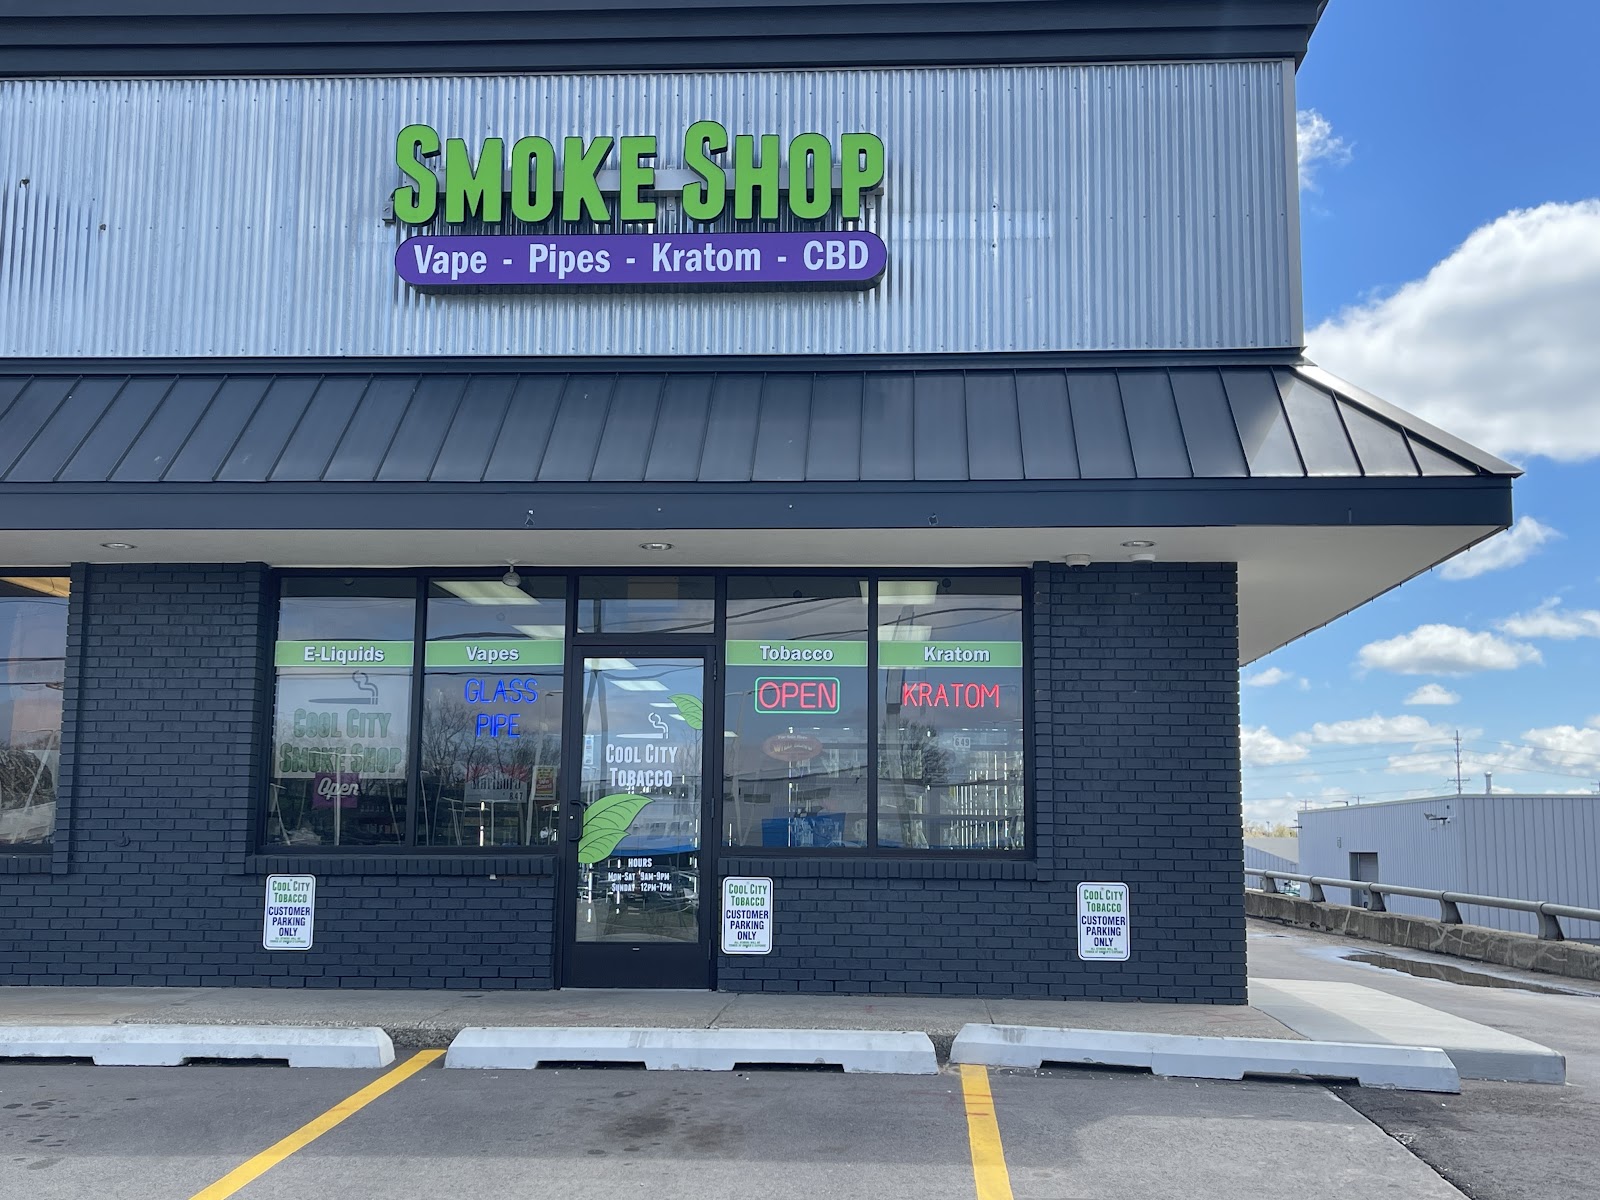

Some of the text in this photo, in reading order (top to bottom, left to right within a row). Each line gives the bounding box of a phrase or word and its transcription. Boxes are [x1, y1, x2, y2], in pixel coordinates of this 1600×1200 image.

[394, 120, 885, 225] SMOKE SHOP
[413, 244, 488, 280] Vape
[528, 242, 611, 279] Pipes
[651, 241, 761, 273] Kratom
[802, 239, 869, 271] CBD
[303, 646, 385, 665] E-Liquids
[465, 646, 520, 664] Vapes
[759, 645, 834, 662] Tobacco
[923, 645, 991, 663] Kratom
[464, 678, 538, 704] GLASS
[758, 681, 837, 709] OPEN
[902, 682, 1000, 708] KRATOM
[293, 708, 392, 738] COOL CITY
[475, 713, 521, 738] PIPE
[954, 737, 970, 747] 649
[605, 743, 642, 763] COOL
[645, 743, 678, 763] CITY
[609, 767, 673, 788] TOBACCO
[317, 777, 359, 800] Open
[628, 858, 652, 868] HOURS
[272, 880, 310, 892] COOL CITY
[728, 883, 767, 895] COOL CITY
[274, 892, 307, 903] TOBACCO
[730, 895, 765, 906] TOBACCO
[1083, 889, 1124, 900] COOL CITY
[268, 906, 311, 916] CUSTOMER
[1086, 901, 1122, 913] TOBACCO
[726, 910, 769, 919] CUSTOMER
[1081, 915, 1126, 926] CUSTOMER
[272, 917, 306, 926] PARKING
[730, 920, 765, 930] PARKING
[279, 927, 298, 937] ONLY
[737, 931, 757, 940] ONLY
[1086, 926, 1122, 936] PARKING
[1093, 937, 1114, 947] ONLY
